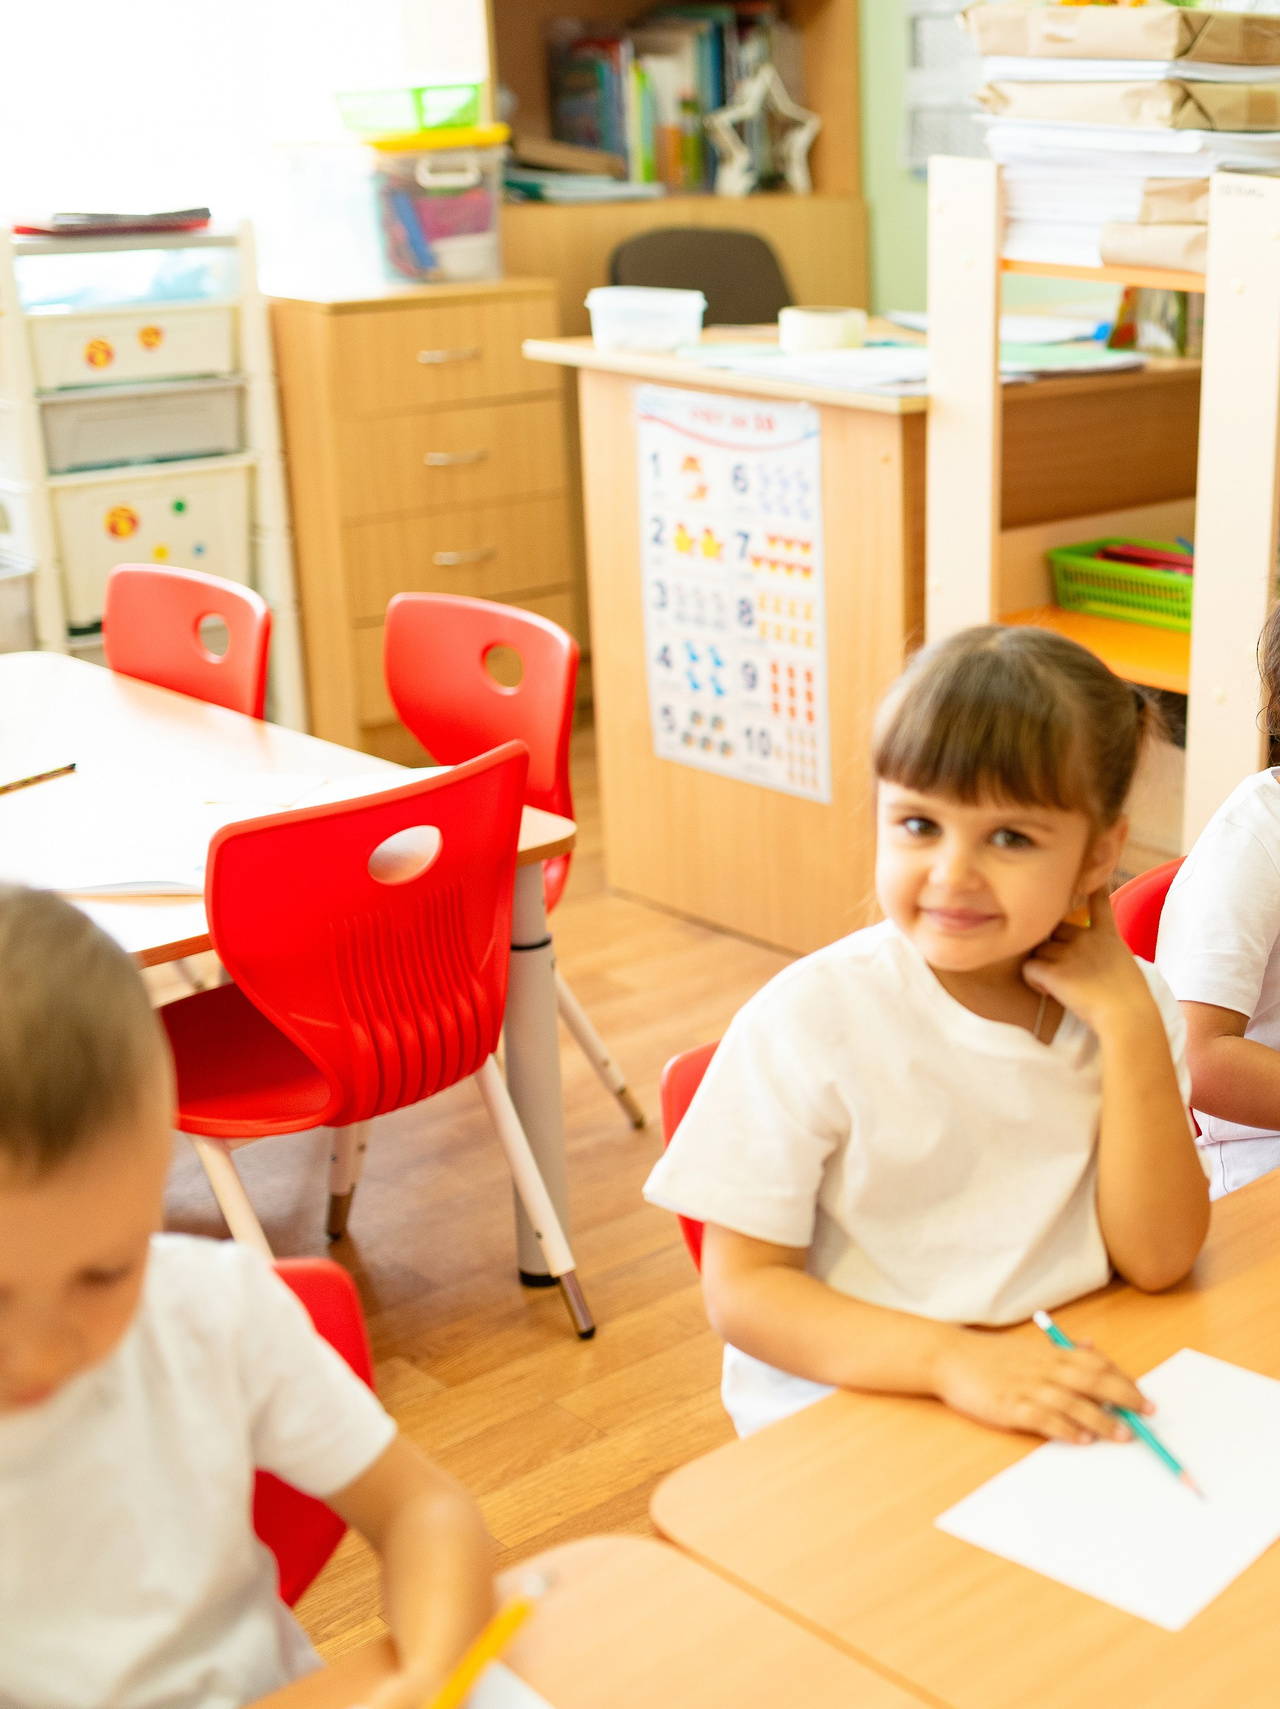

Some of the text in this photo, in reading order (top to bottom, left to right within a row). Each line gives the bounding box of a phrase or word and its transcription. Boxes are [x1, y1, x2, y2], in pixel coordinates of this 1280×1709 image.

[650, 452, 662, 478] 1
[731, 464, 749, 494] 6
[651, 517, 666, 546] 2
[734, 531, 750, 560] 7
[653, 581, 668, 610] 3
[737, 597, 754, 628] 8
[656, 645, 672, 669] 4
[741, 663, 757, 691] 9
[744, 727, 772, 758] 10
